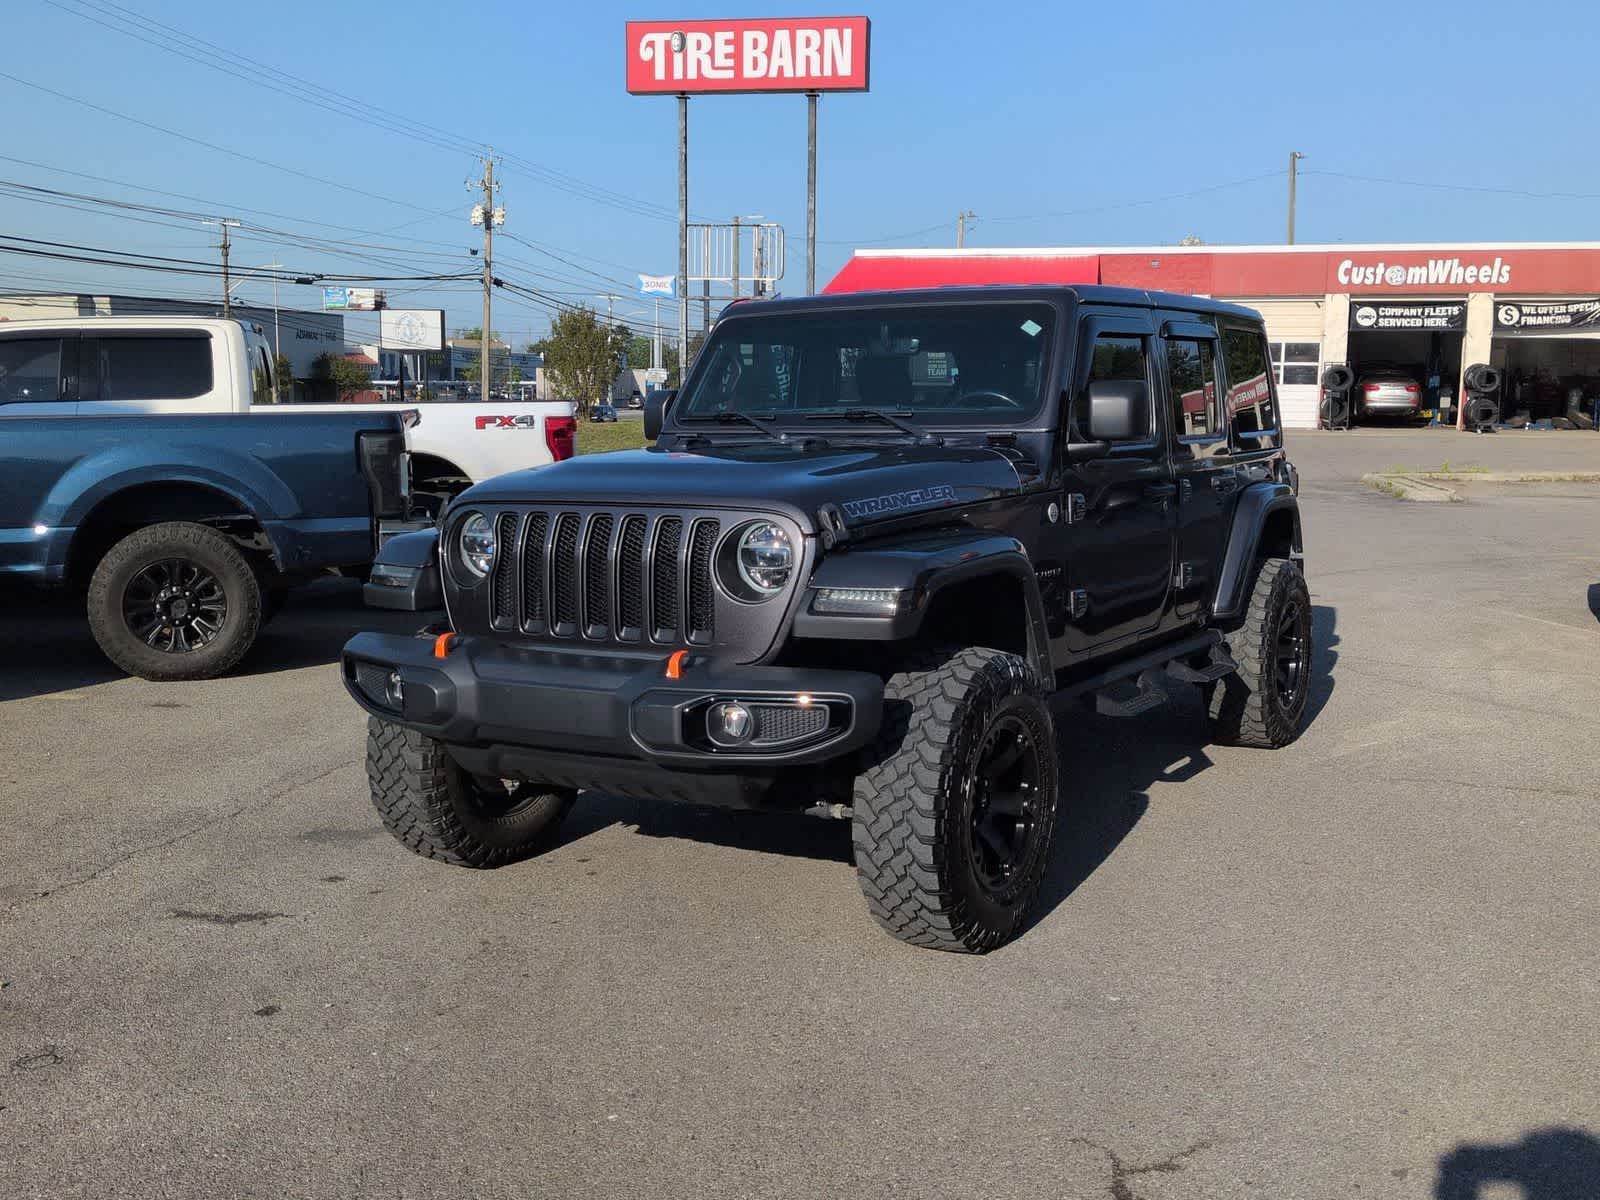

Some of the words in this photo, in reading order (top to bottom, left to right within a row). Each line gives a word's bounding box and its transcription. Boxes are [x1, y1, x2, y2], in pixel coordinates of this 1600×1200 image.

[742, 28, 852, 79] BARN
[645, 280, 669, 289] SONIC
[1379, 307, 1422, 316] COMPANY
[1424, 306, 1460, 316] FLEETS
[1521, 305, 1537, 314] WE
[1537, 305, 1567, 314] OFFER
[1378, 317, 1423, 327] SERVICED
[1424, 317, 1449, 327] HERE
[1521, 315, 1572, 326] FINANCING
[475, 415, 535, 430] FX4
[842, 484, 956, 516] WRANGLER
